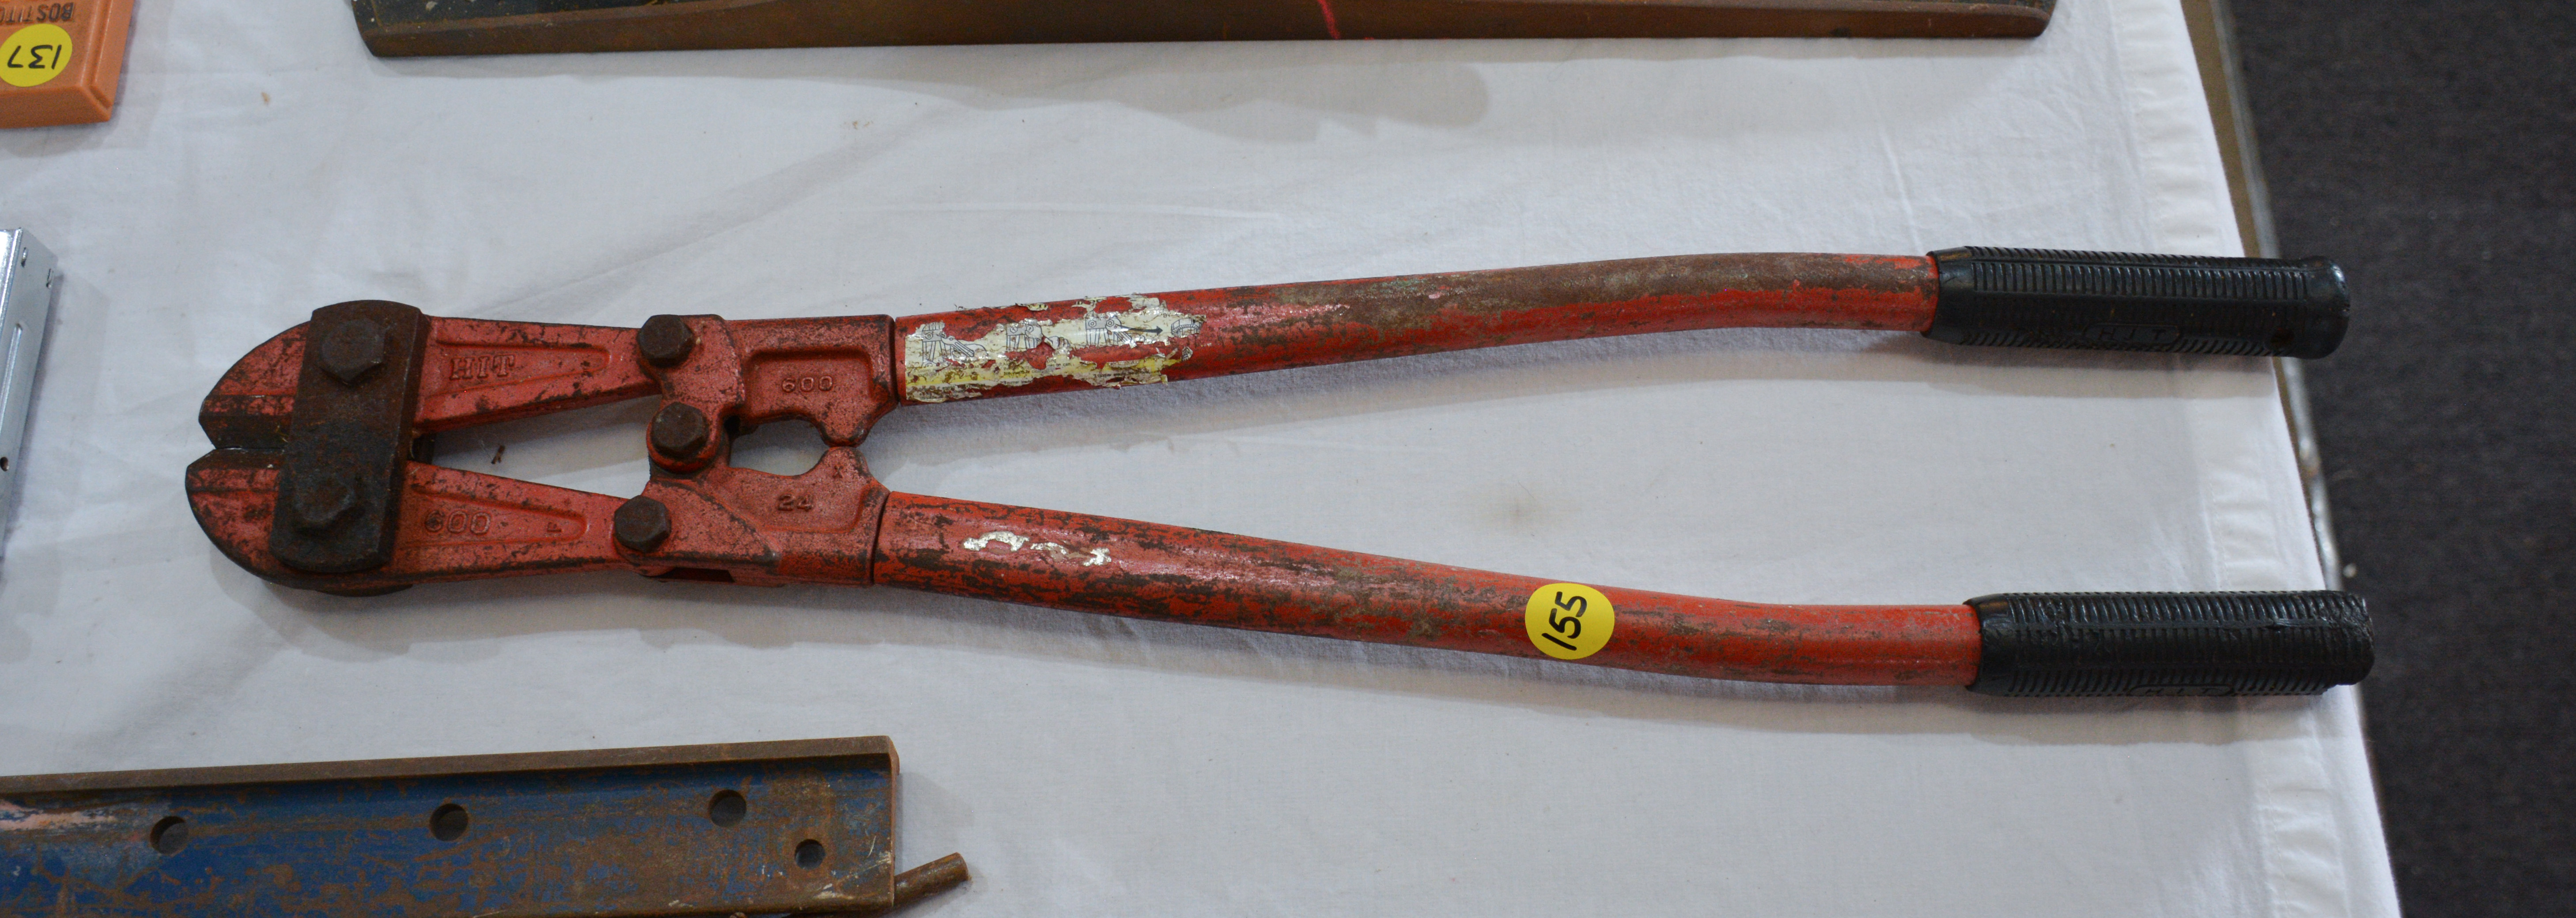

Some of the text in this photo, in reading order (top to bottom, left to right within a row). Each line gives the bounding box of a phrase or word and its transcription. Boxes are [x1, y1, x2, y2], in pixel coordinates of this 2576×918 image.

[7, 44, 62, 70] 137
[449, 355, 515, 381] HIT
[781, 375, 833, 393] 600
[777, 493, 814, 512] 24
[424, 509, 492, 536] 600
[1541, 591, 1588, 651] 155
